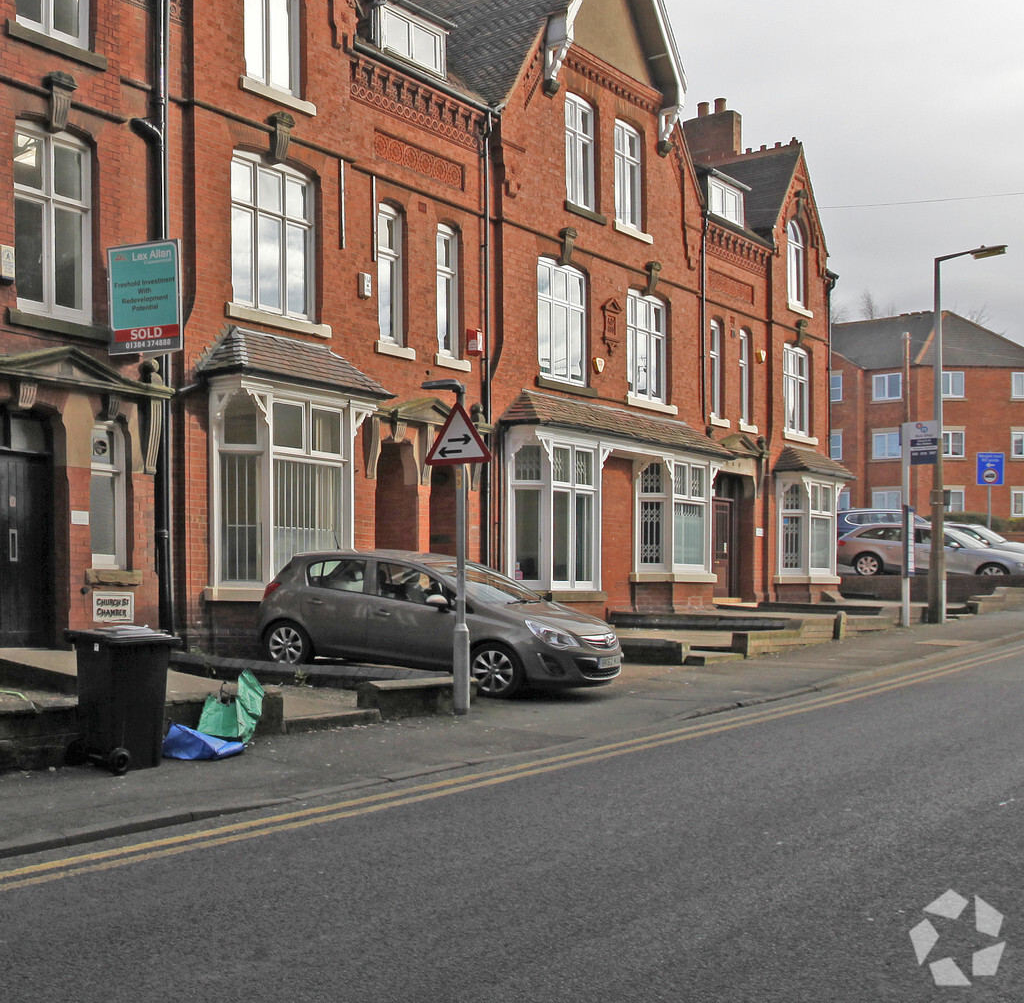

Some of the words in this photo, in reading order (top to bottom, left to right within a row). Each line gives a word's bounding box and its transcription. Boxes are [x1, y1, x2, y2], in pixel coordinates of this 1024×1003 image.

[132, 251, 148, 262] Lex
[149, 249, 172, 260] Allan
[114, 280, 141, 289] Freehold
[141, 277, 175, 286] Investment
[122, 295, 169, 304] Redevelopment
[132, 304, 159, 312] Potential
[130, 327, 163, 340] SOLD
[125, 341, 146, 349] 01384
[147, 339, 172, 348] 374888
[96, 598, 121, 607] CHURCH
